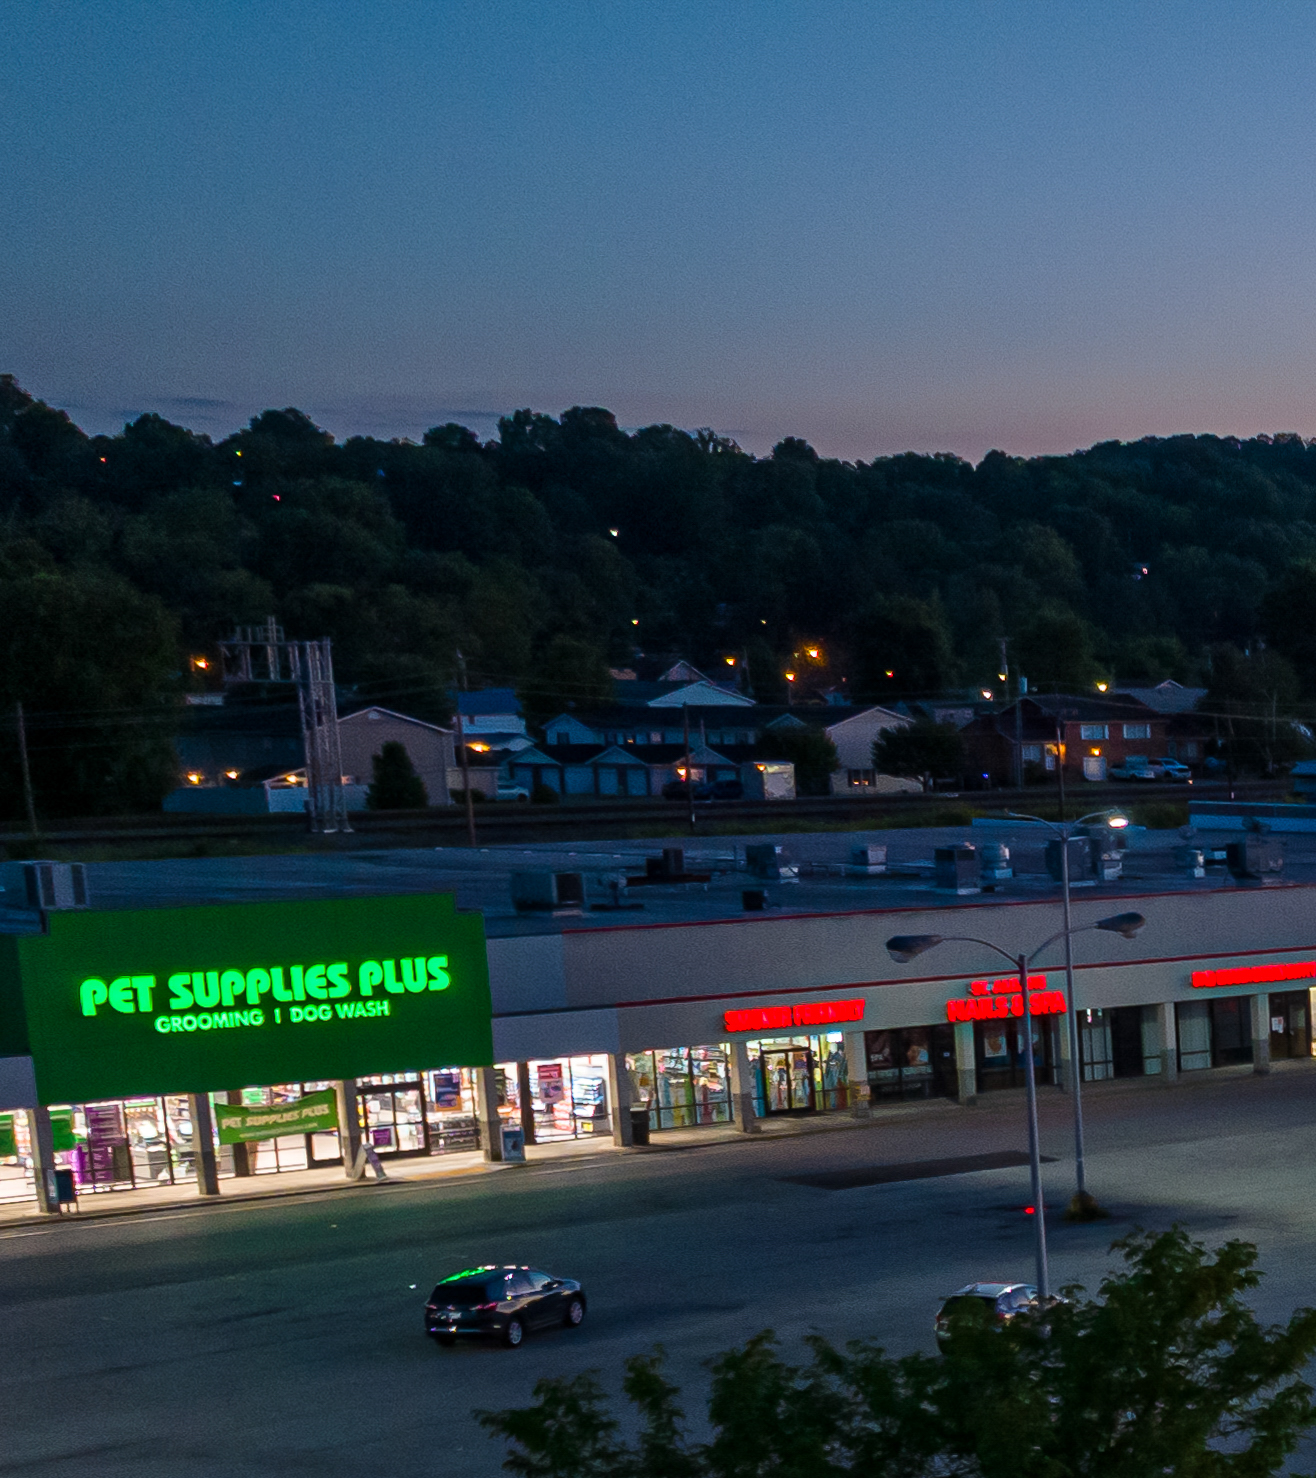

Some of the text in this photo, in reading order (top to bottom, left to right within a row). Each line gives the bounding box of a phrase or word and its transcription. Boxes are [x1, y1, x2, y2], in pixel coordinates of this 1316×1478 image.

[79, 954, 451, 1016] PET SUPPLIES PLUS
[154, 999, 390, 1034] GROOMING DOG WASH
[946, 996, 1009, 1022] NAILS
[1029, 990, 1067, 1015] SPA
[221, 1117, 242, 1130] PET
[245, 1110, 300, 1127] SUPPLIES
[301, 1103, 330, 1118] PLUS
